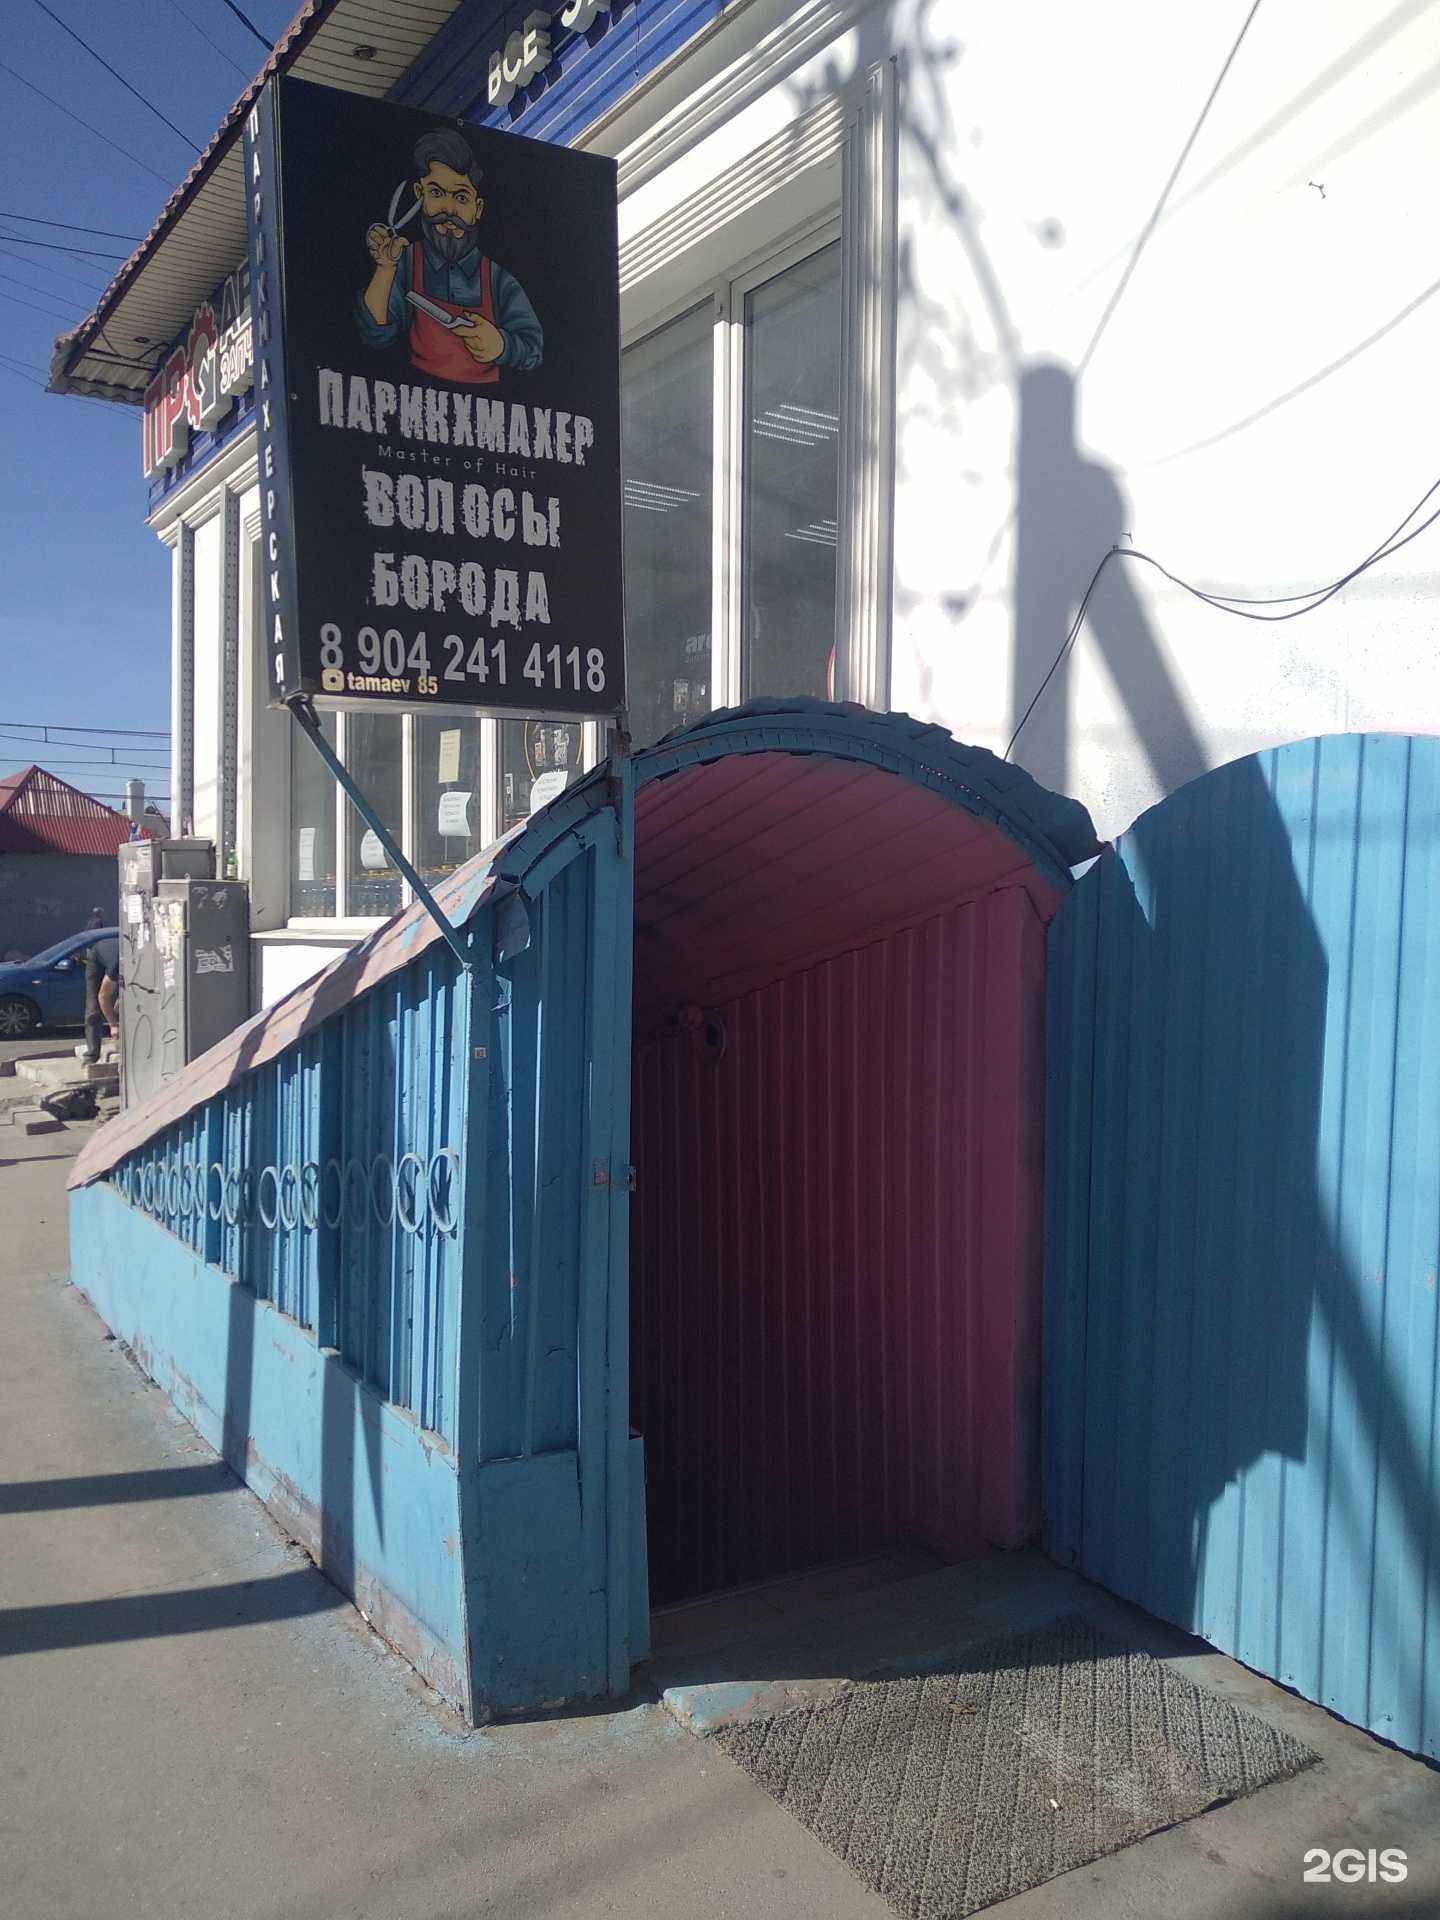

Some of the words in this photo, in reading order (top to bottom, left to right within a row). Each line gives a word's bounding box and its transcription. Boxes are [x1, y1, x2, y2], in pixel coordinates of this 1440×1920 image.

[249, 104, 284, 684] ПАРИКМАХЕРСКАЯ
[318, 367, 594, 466] ПАРИКХМАХЕР
[378, 444, 451, 466] Master
[463, 457, 484, 473] of
[496, 462, 537, 479] Hair
[363, 465, 560, 547] ВОЛОСЫ
[372, 552, 550, 631] БОРОДА
[320, 622, 343, 670] 8
[357, 626, 431, 678] 904
[443, 634, 506, 685] 241
[523, 642, 605, 692] 4118
[347, 672, 410, 693] tamaev
[417, 675, 438, 695] 85
